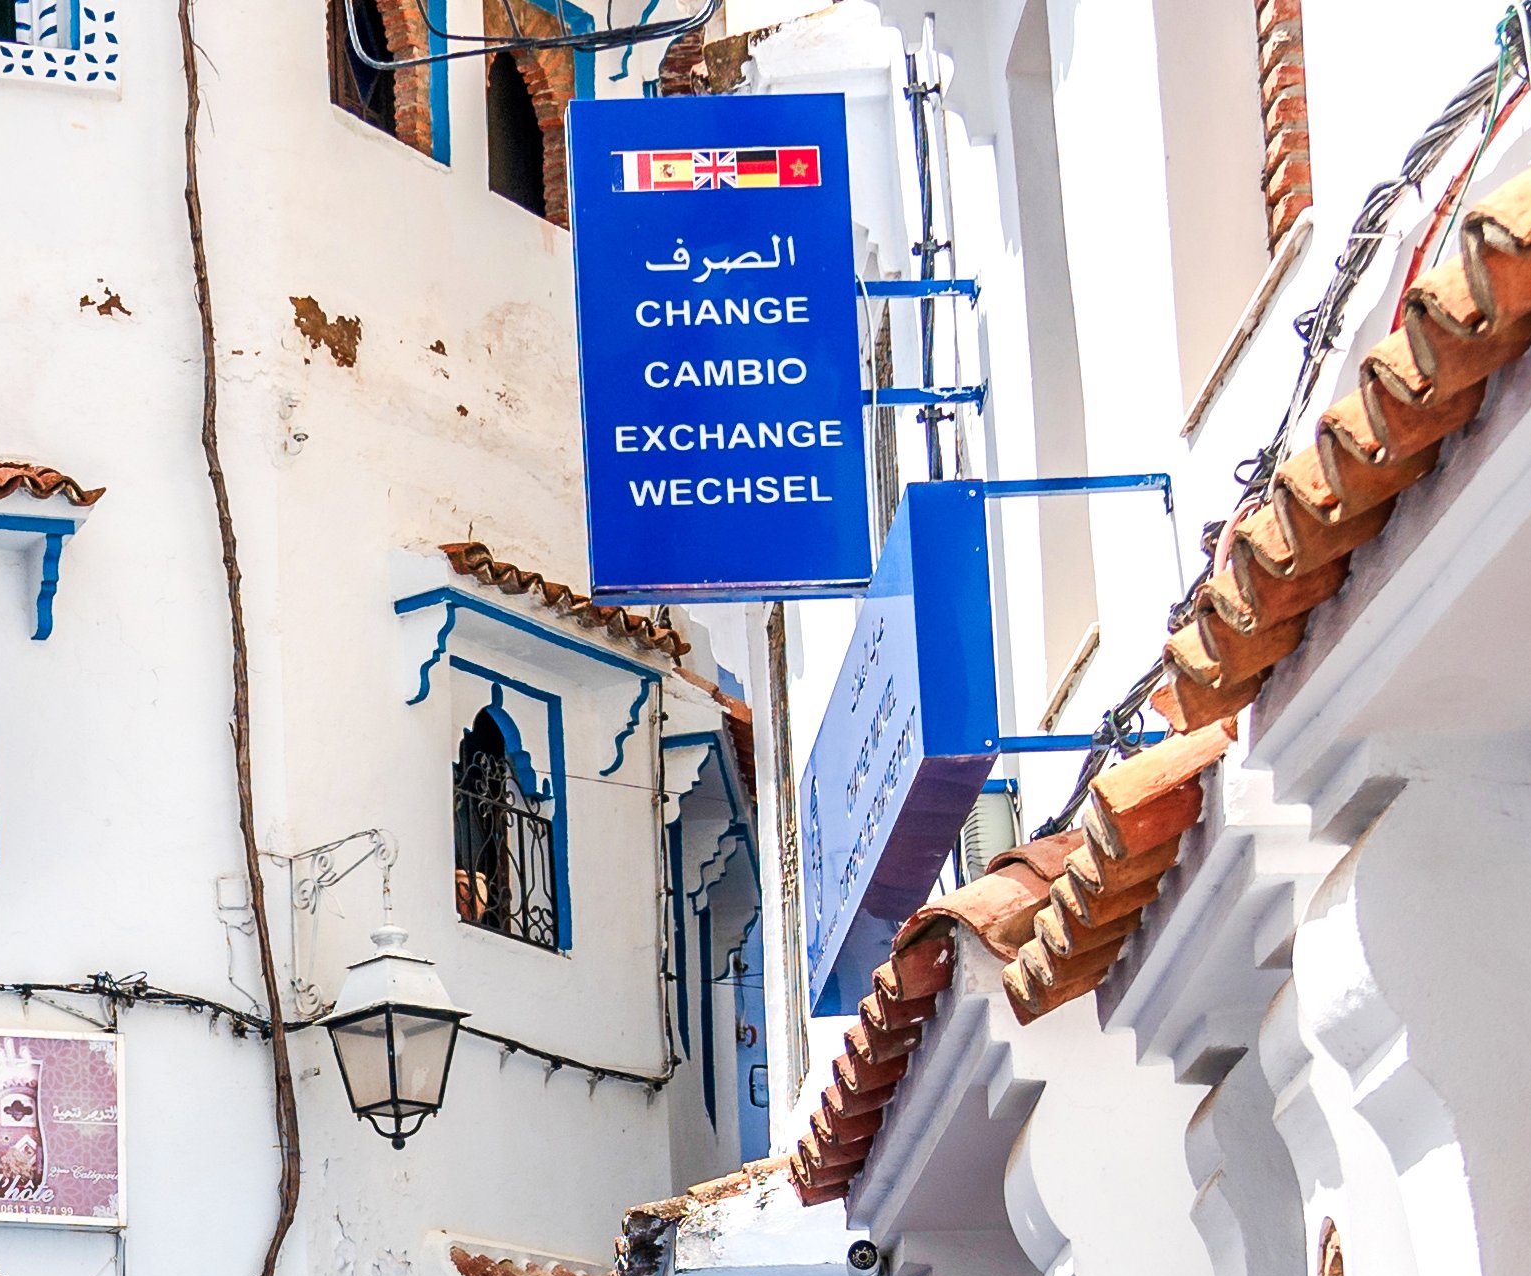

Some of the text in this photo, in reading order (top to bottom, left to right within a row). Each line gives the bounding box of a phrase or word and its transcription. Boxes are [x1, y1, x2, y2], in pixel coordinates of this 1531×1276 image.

[645, 234, 797, 284] الصرف
[635, 296, 810, 328] CHANGE
[643, 357, 807, 388] CAMBIO
[614, 419, 844, 453] EXCHANGE
[628, 474, 833, 508] WECHSEL
[846, 736, 870, 818] CHANGE
